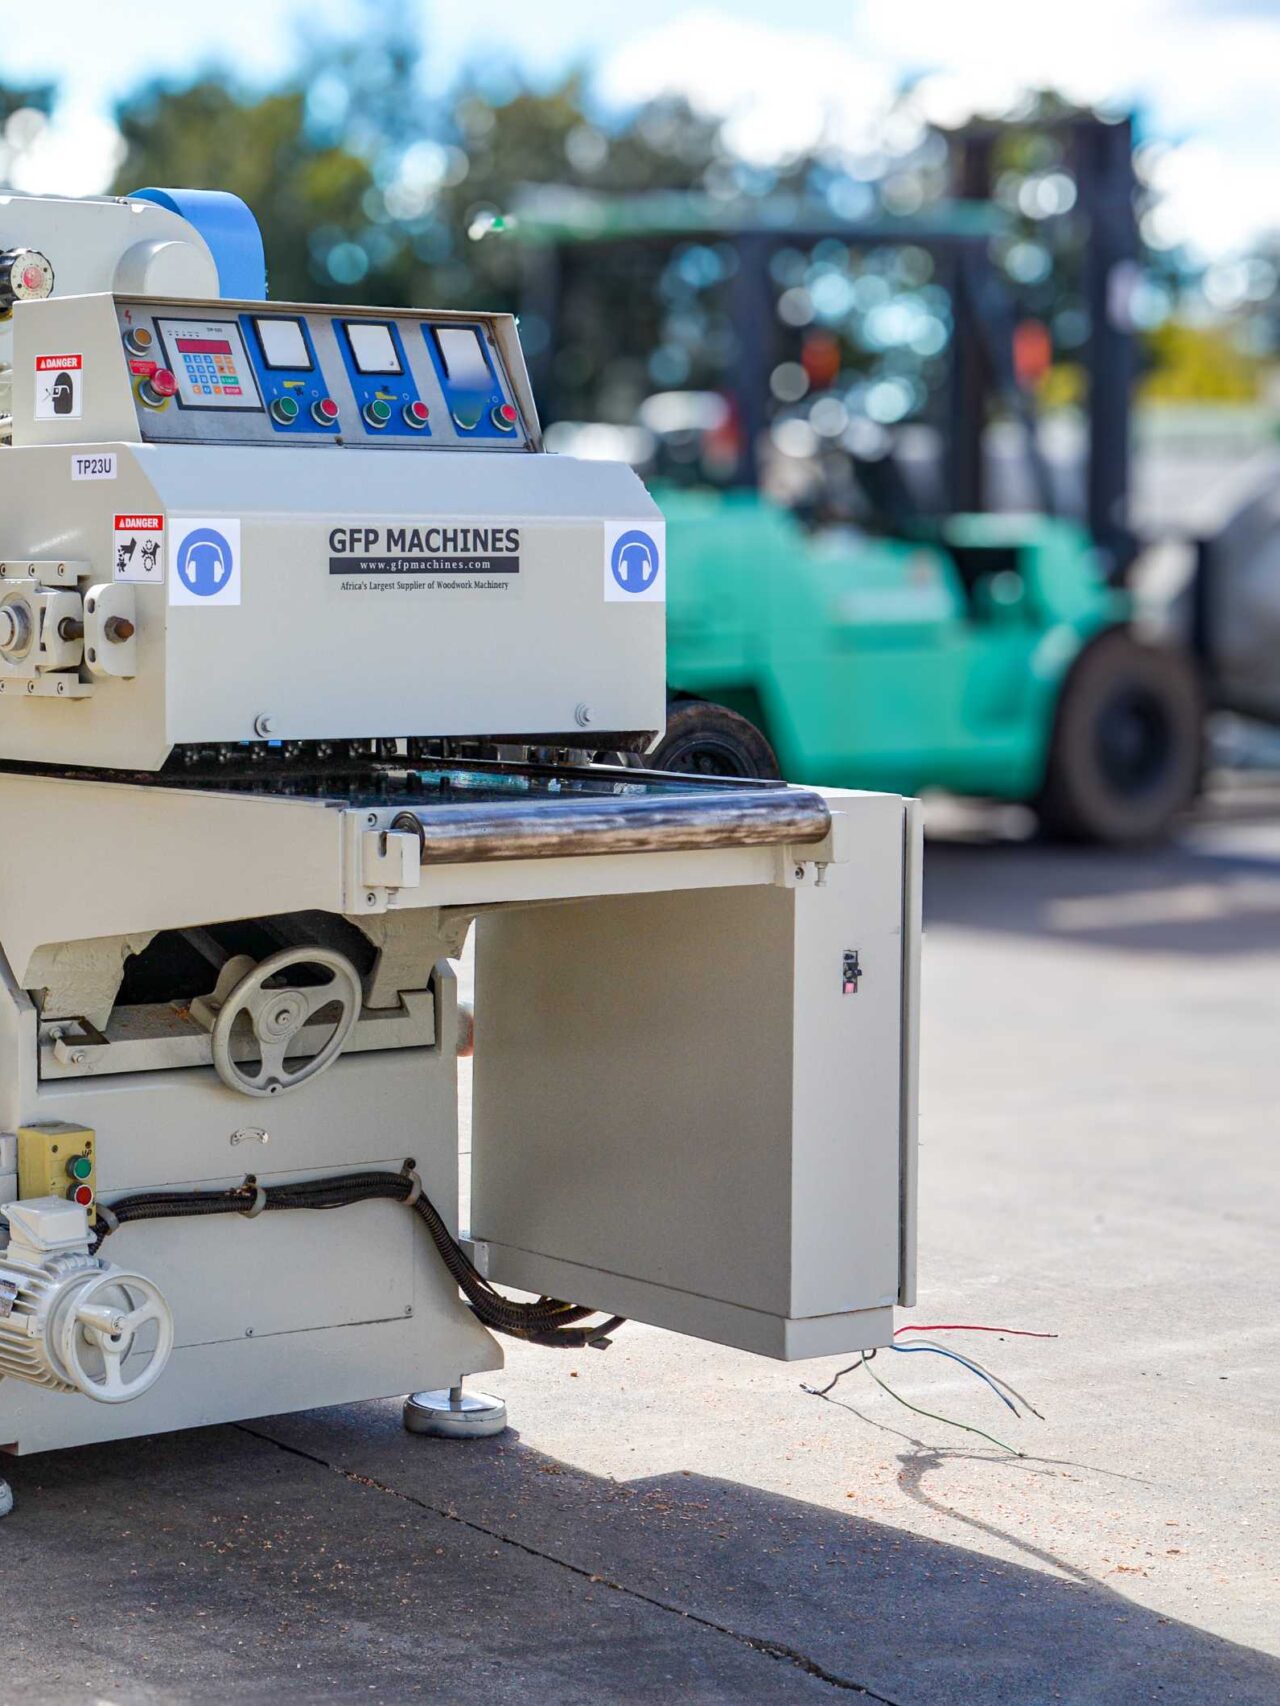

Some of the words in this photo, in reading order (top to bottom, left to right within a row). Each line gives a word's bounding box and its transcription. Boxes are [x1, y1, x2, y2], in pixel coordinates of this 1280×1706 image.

[46, 357, 78, 369] DANGER
[76, 458, 112, 475] TP23U
[125, 517, 159, 528] DANGER
[329, 528, 379, 553] GFP
[386, 528, 520, 553] MACHINES
[360, 560, 491, 571] www.gfpmachines.com
[341, 581, 367, 591] Africa's
[369, 581, 395, 591] Largest
[396, 581, 425, 591] Supplier
[427, 580, 435, 590] of
[437, 580, 472, 590] Woodwork
[474, 580, 509, 590] Machinery
